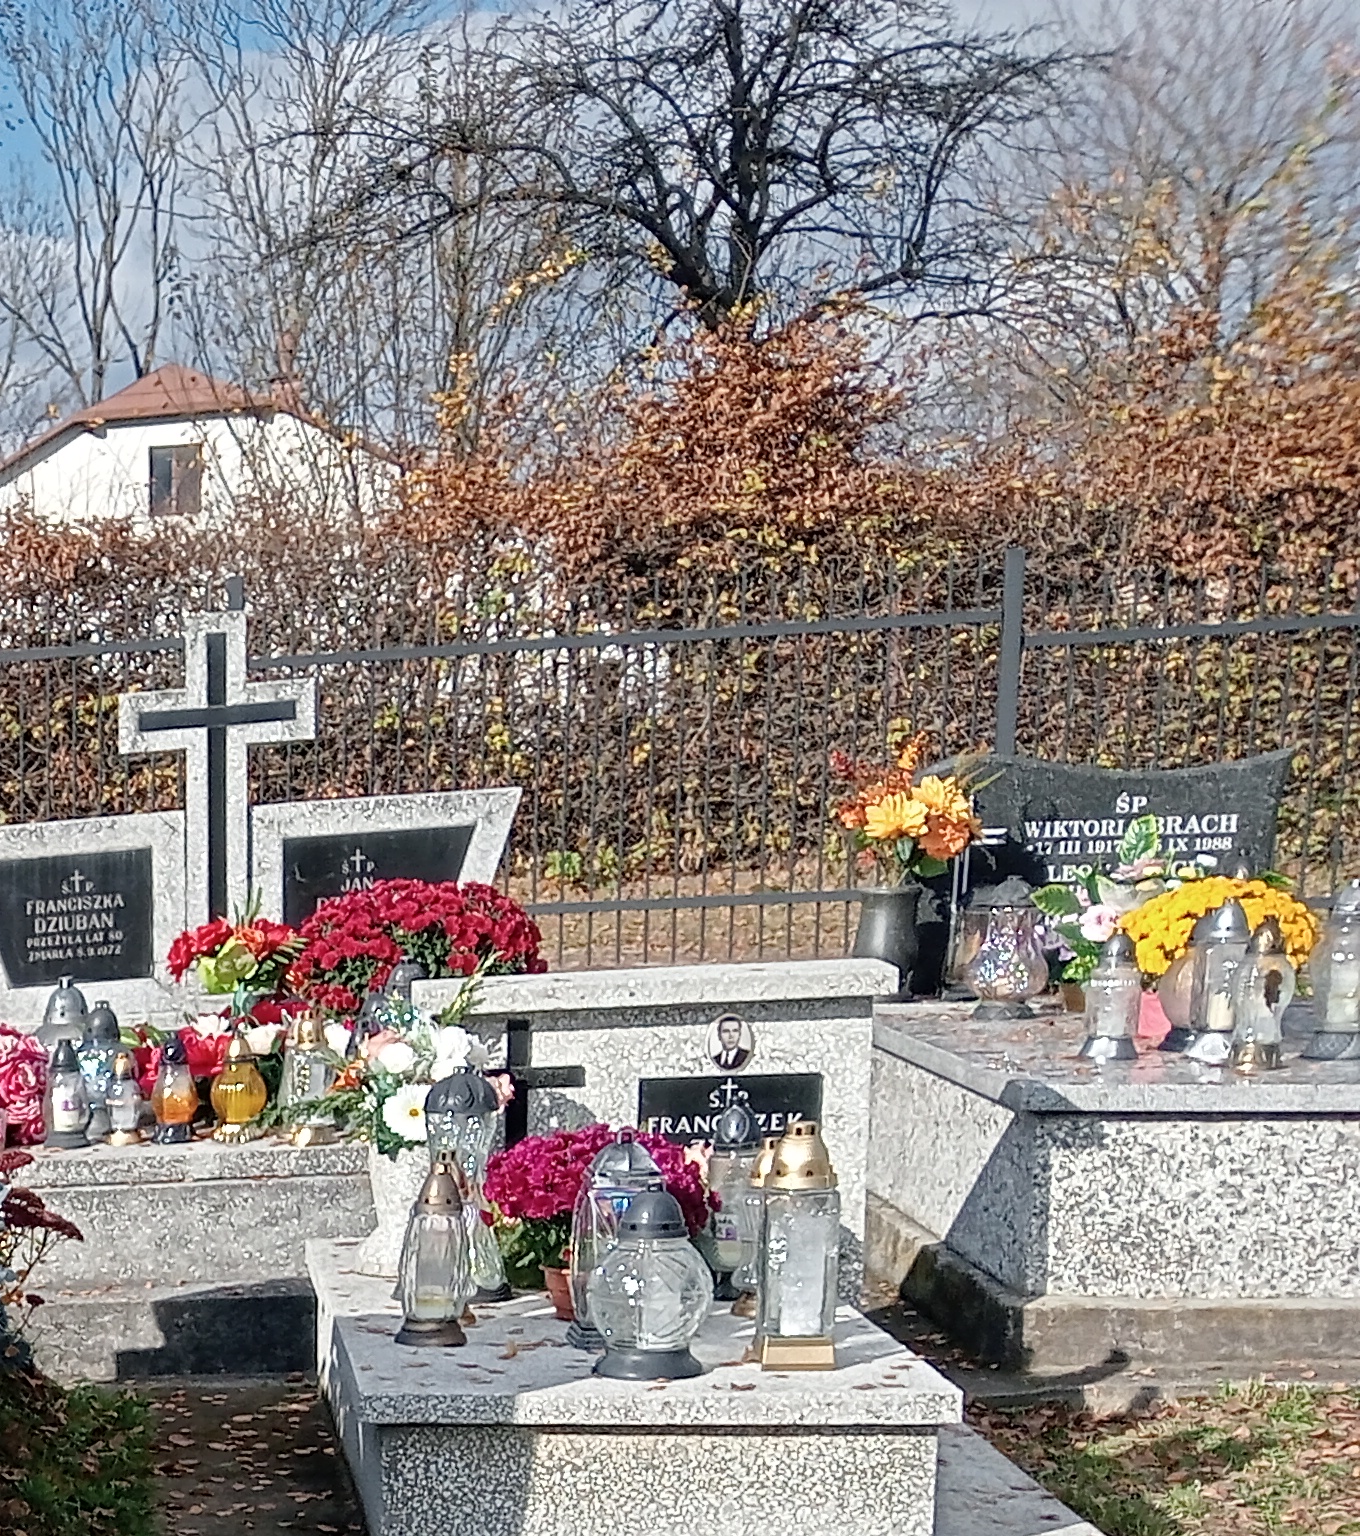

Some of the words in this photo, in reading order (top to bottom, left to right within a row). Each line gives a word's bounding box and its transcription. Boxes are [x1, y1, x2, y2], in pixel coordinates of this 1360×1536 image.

[1024, 819, 1129, 838] WIKTORI
[341, 876, 374, 893] JAN
[26, 893, 125, 915] FRANCISZKA
[34, 912, 114, 934] DZIUBAN
